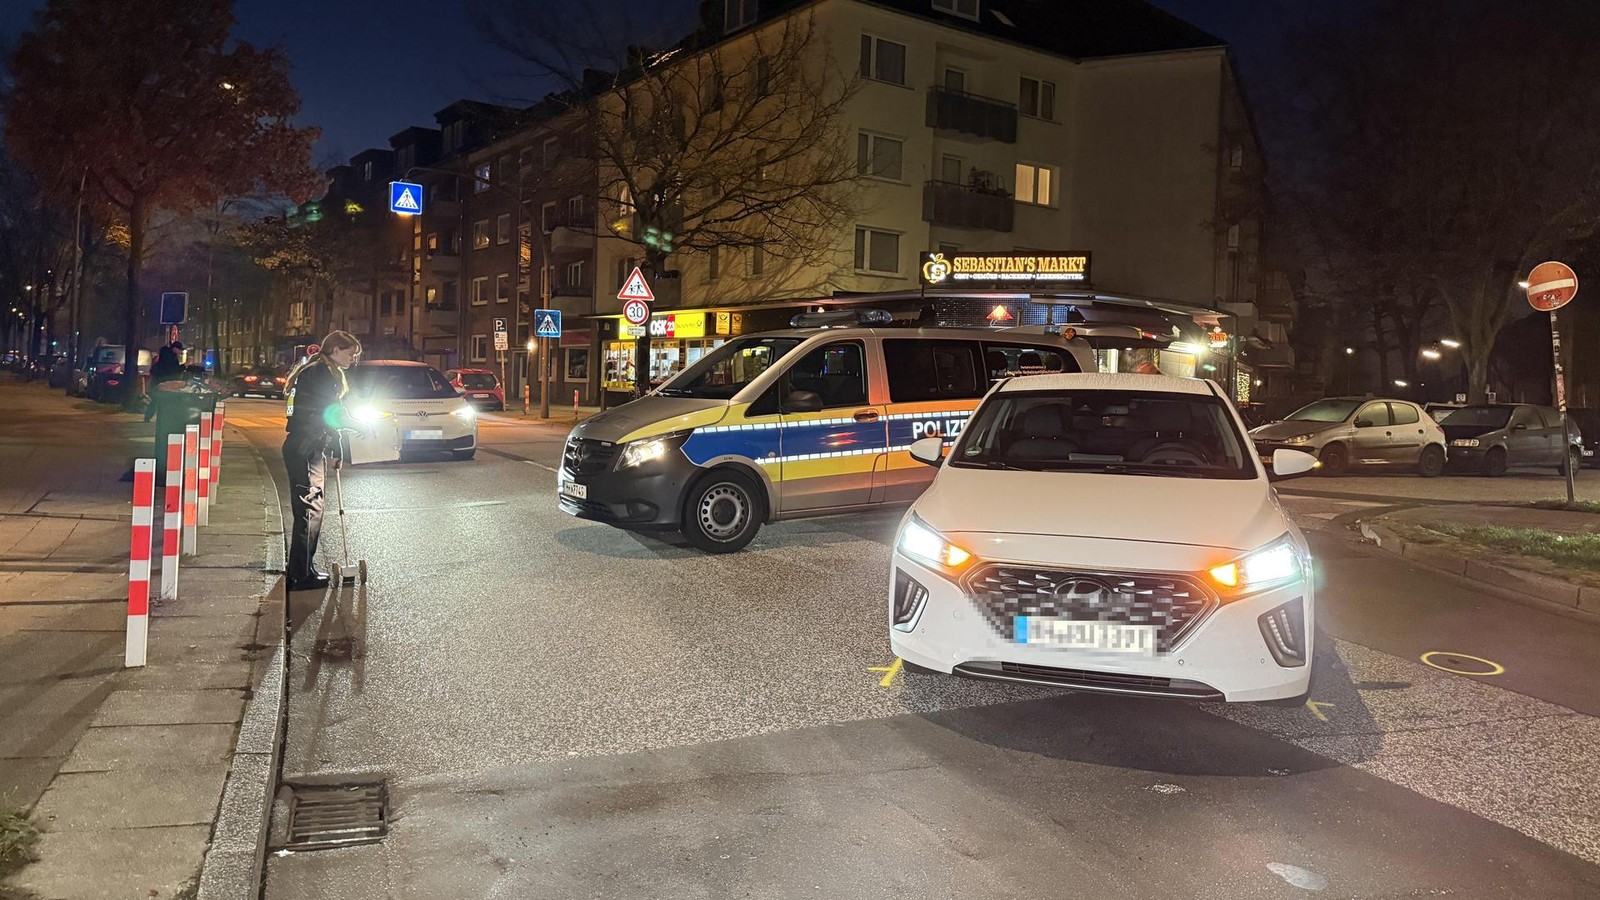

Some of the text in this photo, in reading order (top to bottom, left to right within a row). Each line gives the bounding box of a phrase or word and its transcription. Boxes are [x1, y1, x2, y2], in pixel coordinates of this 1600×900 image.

[953, 257, 1086, 273] SEBASTIAN'S MARKT
[629, 306, 644, 319] 30
